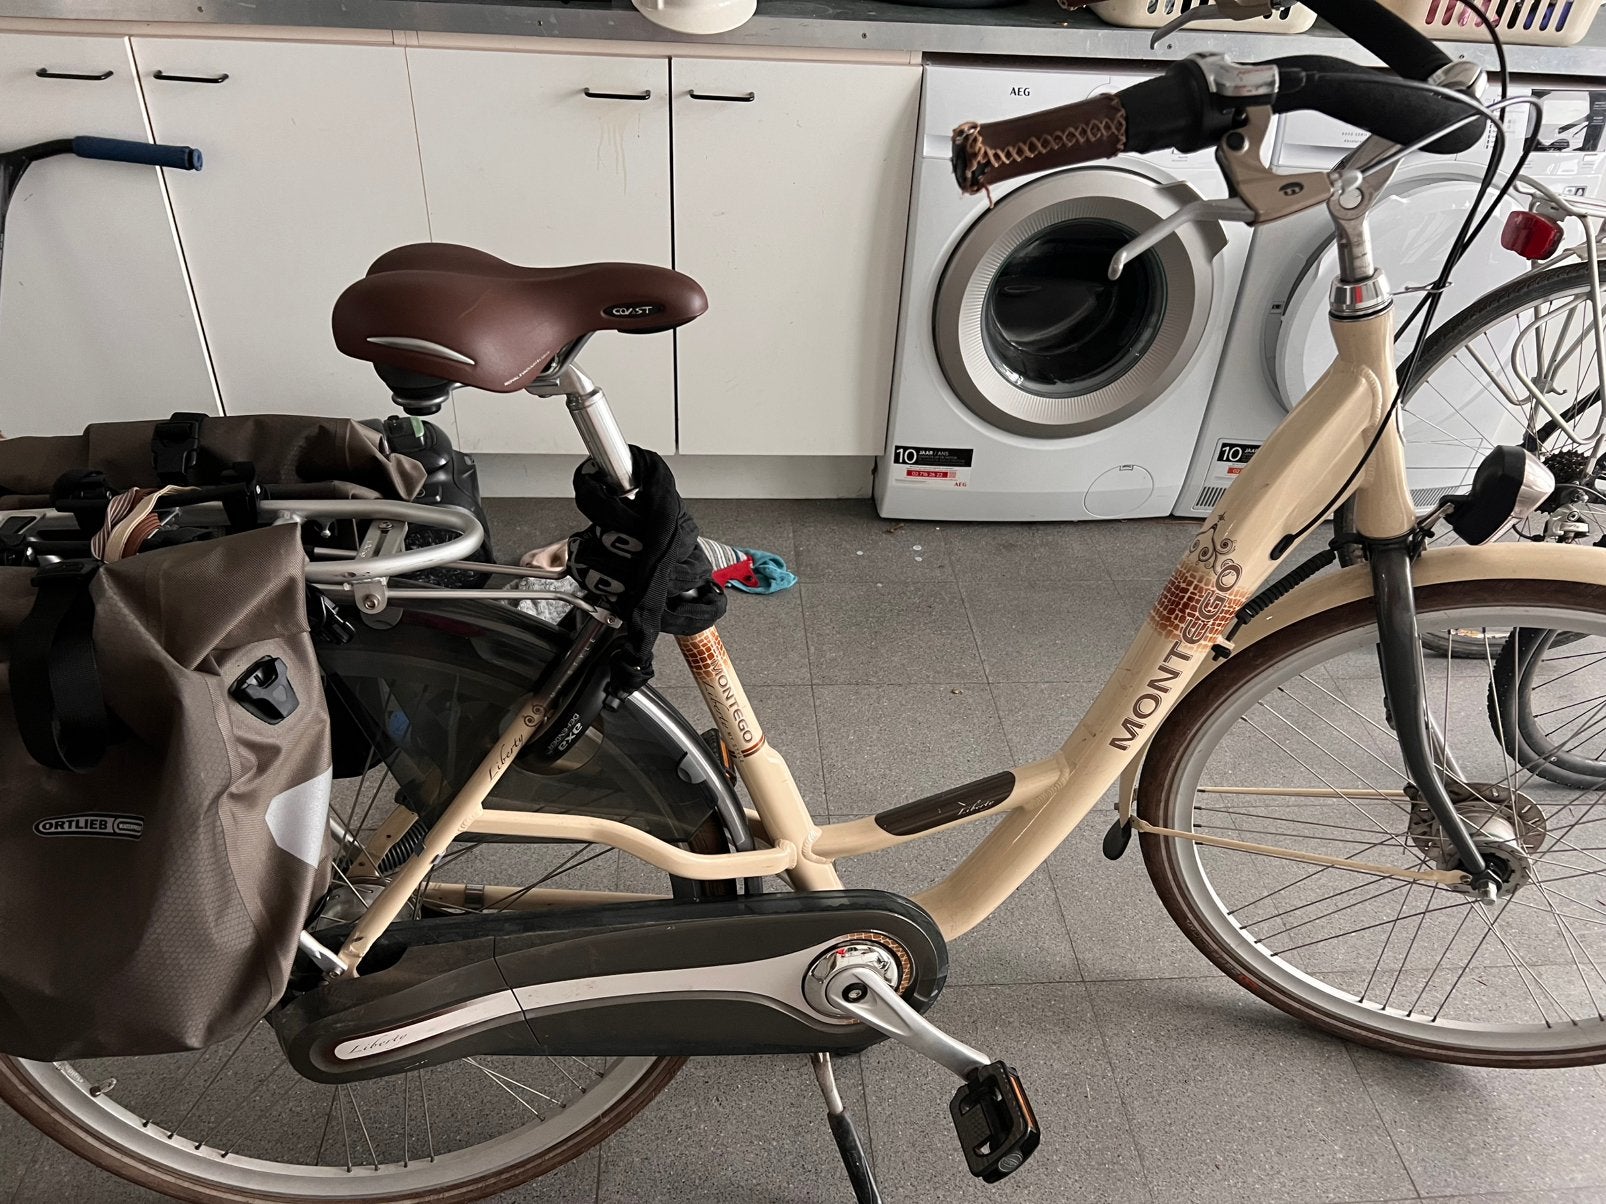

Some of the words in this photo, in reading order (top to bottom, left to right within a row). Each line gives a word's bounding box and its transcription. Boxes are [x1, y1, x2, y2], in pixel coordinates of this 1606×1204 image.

[1009, 87, 1030, 96] AEG
[612, 306, 653, 315] COAST
[896, 448, 917, 464] 10
[1222, 446, 1242, 461] 10
[1109, 562, 1243, 752] MONTEGO
[710, 658, 753, 744] MONTEGO
[488, 733, 524, 781] Liberty
[41, 818, 108, 831] ORTLIEB
[348, 1033, 408, 1054] Liberty
